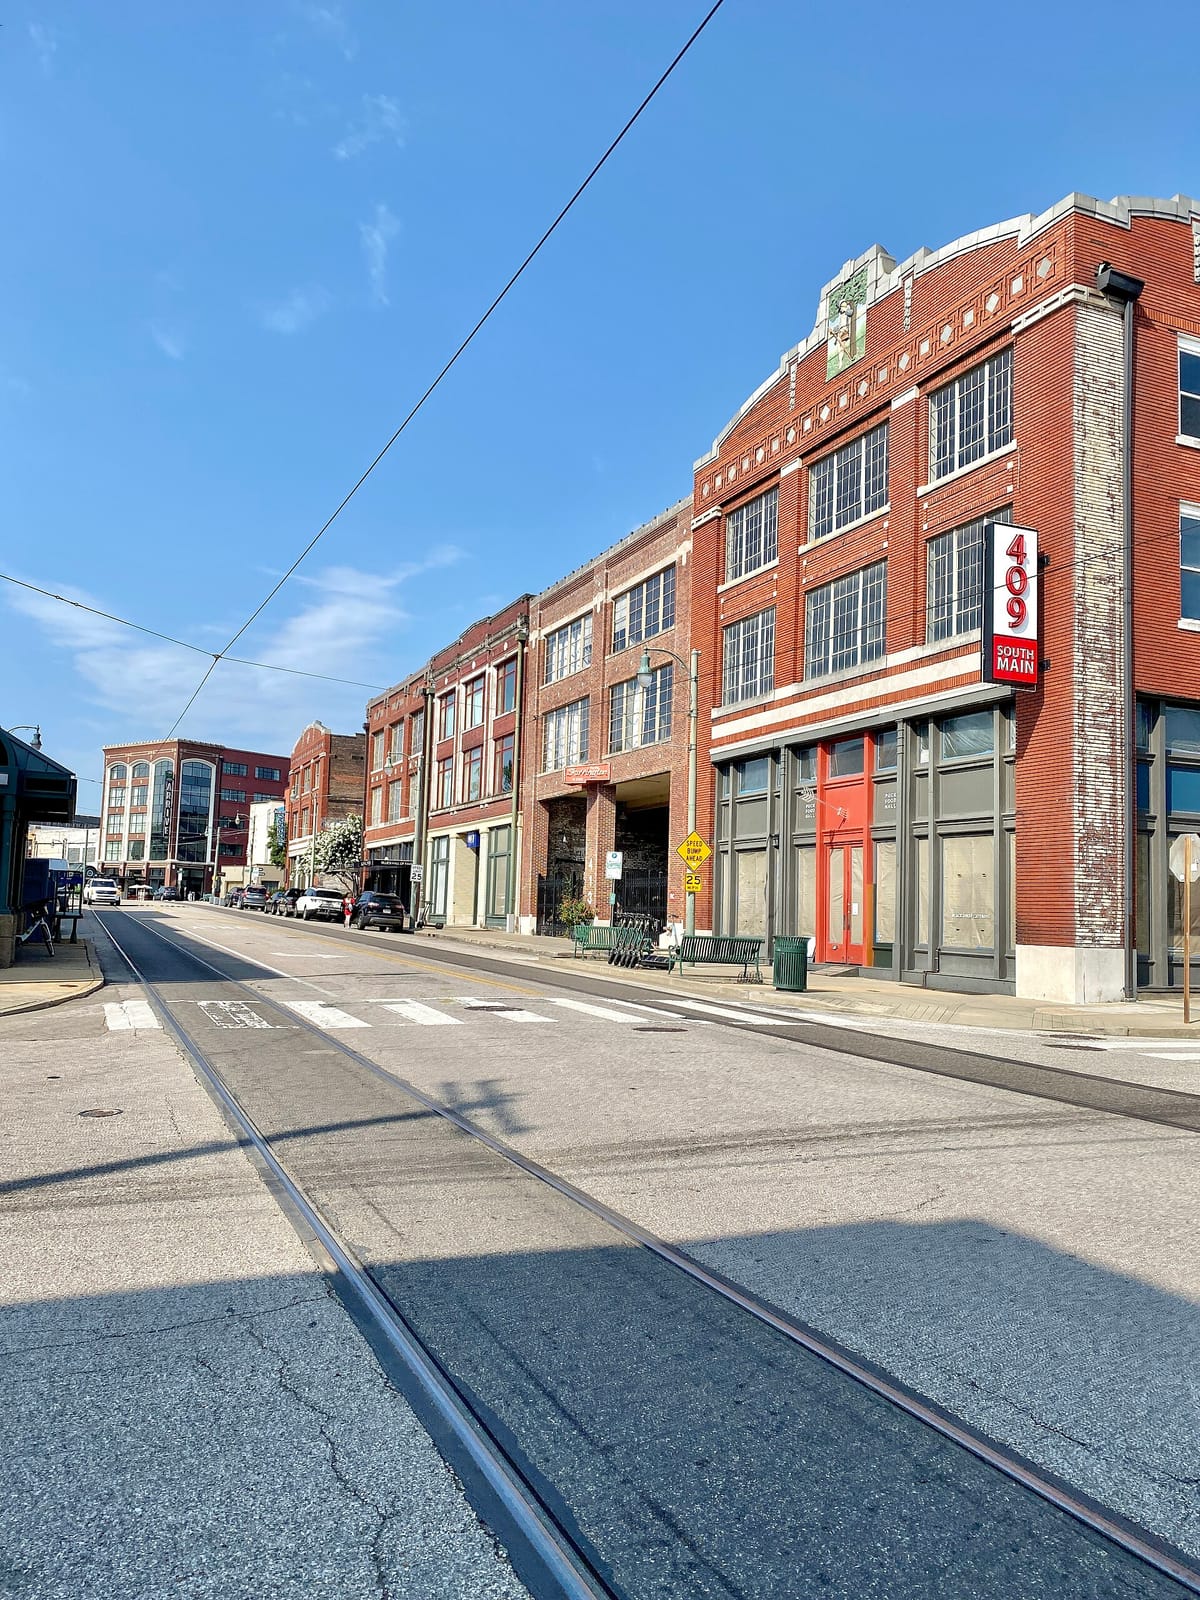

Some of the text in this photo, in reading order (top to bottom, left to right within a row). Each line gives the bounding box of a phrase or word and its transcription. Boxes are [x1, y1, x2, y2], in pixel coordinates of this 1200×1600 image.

[1005, 533, 1028, 630] 409
[996, 644, 1035, 661] SOUTH
[996, 658, 1035, 675] MAIN
[164, 782, 173, 835] ARRIVE
[411, 872, 422, 880] 25
[686, 875, 701, 885] 25
